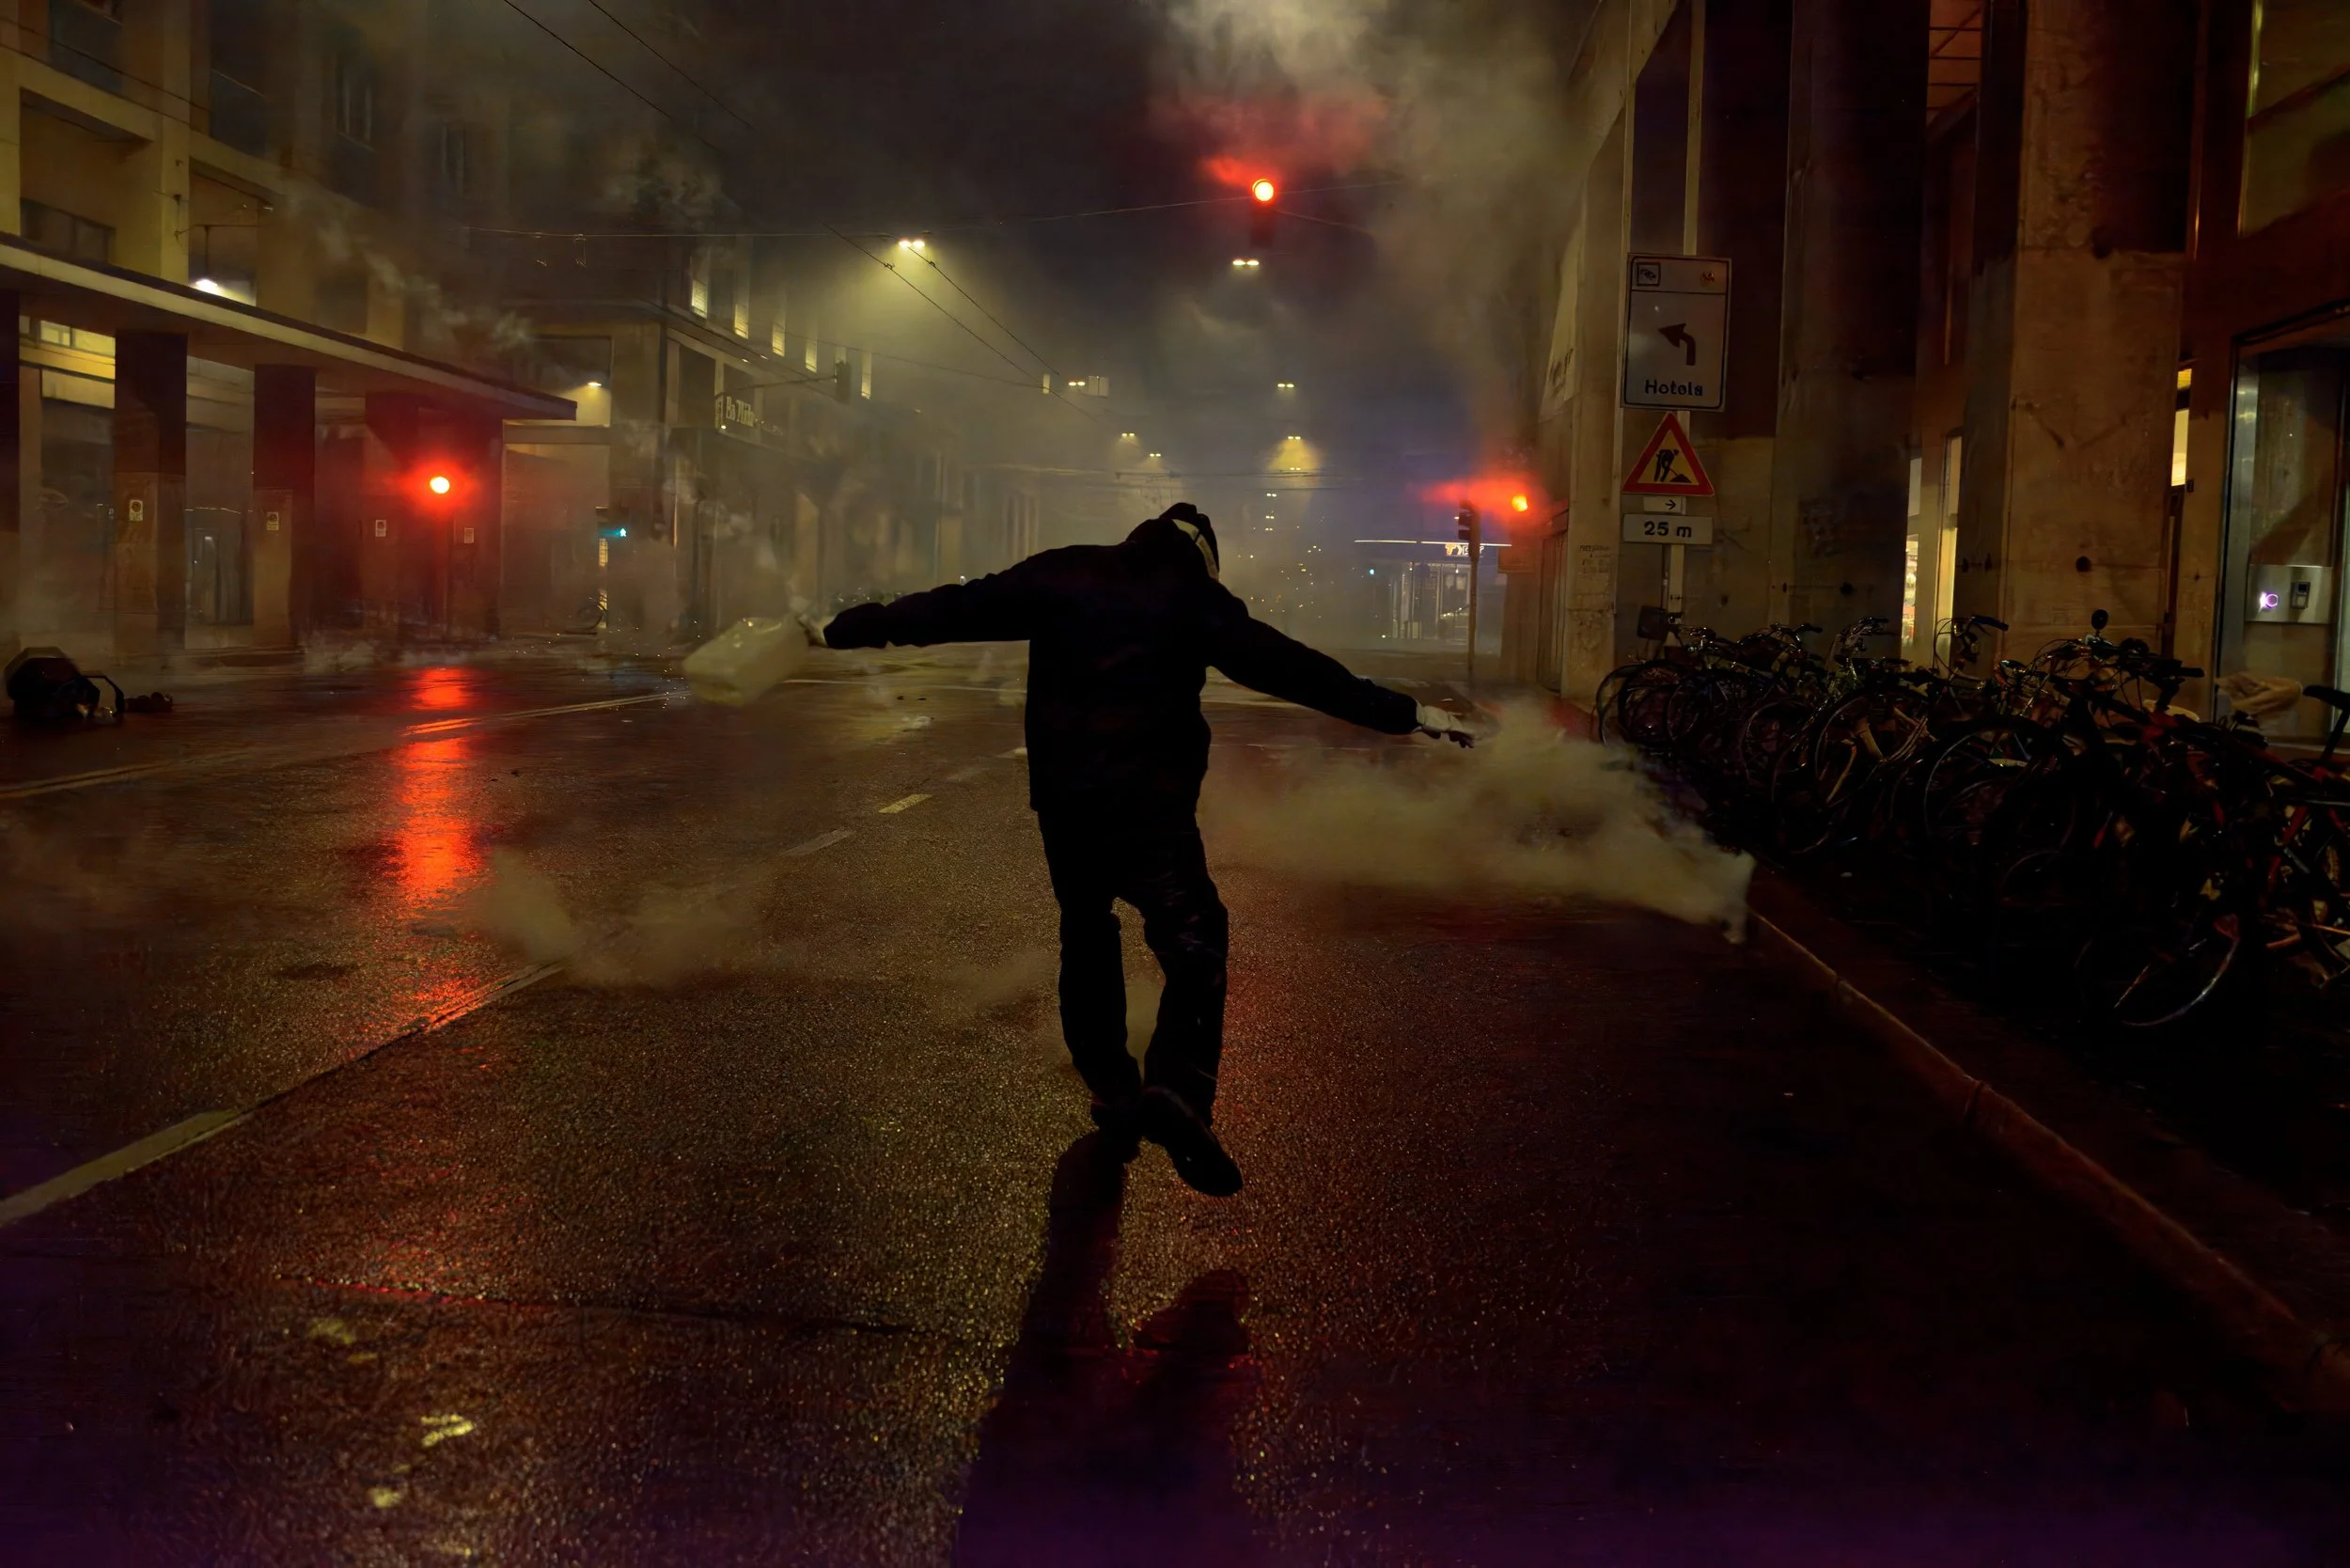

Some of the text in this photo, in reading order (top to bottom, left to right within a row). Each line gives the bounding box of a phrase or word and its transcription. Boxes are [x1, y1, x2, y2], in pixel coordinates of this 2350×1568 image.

[1645, 379, 1702, 396] Hotels
[1644, 521, 1692, 538] 25 m
